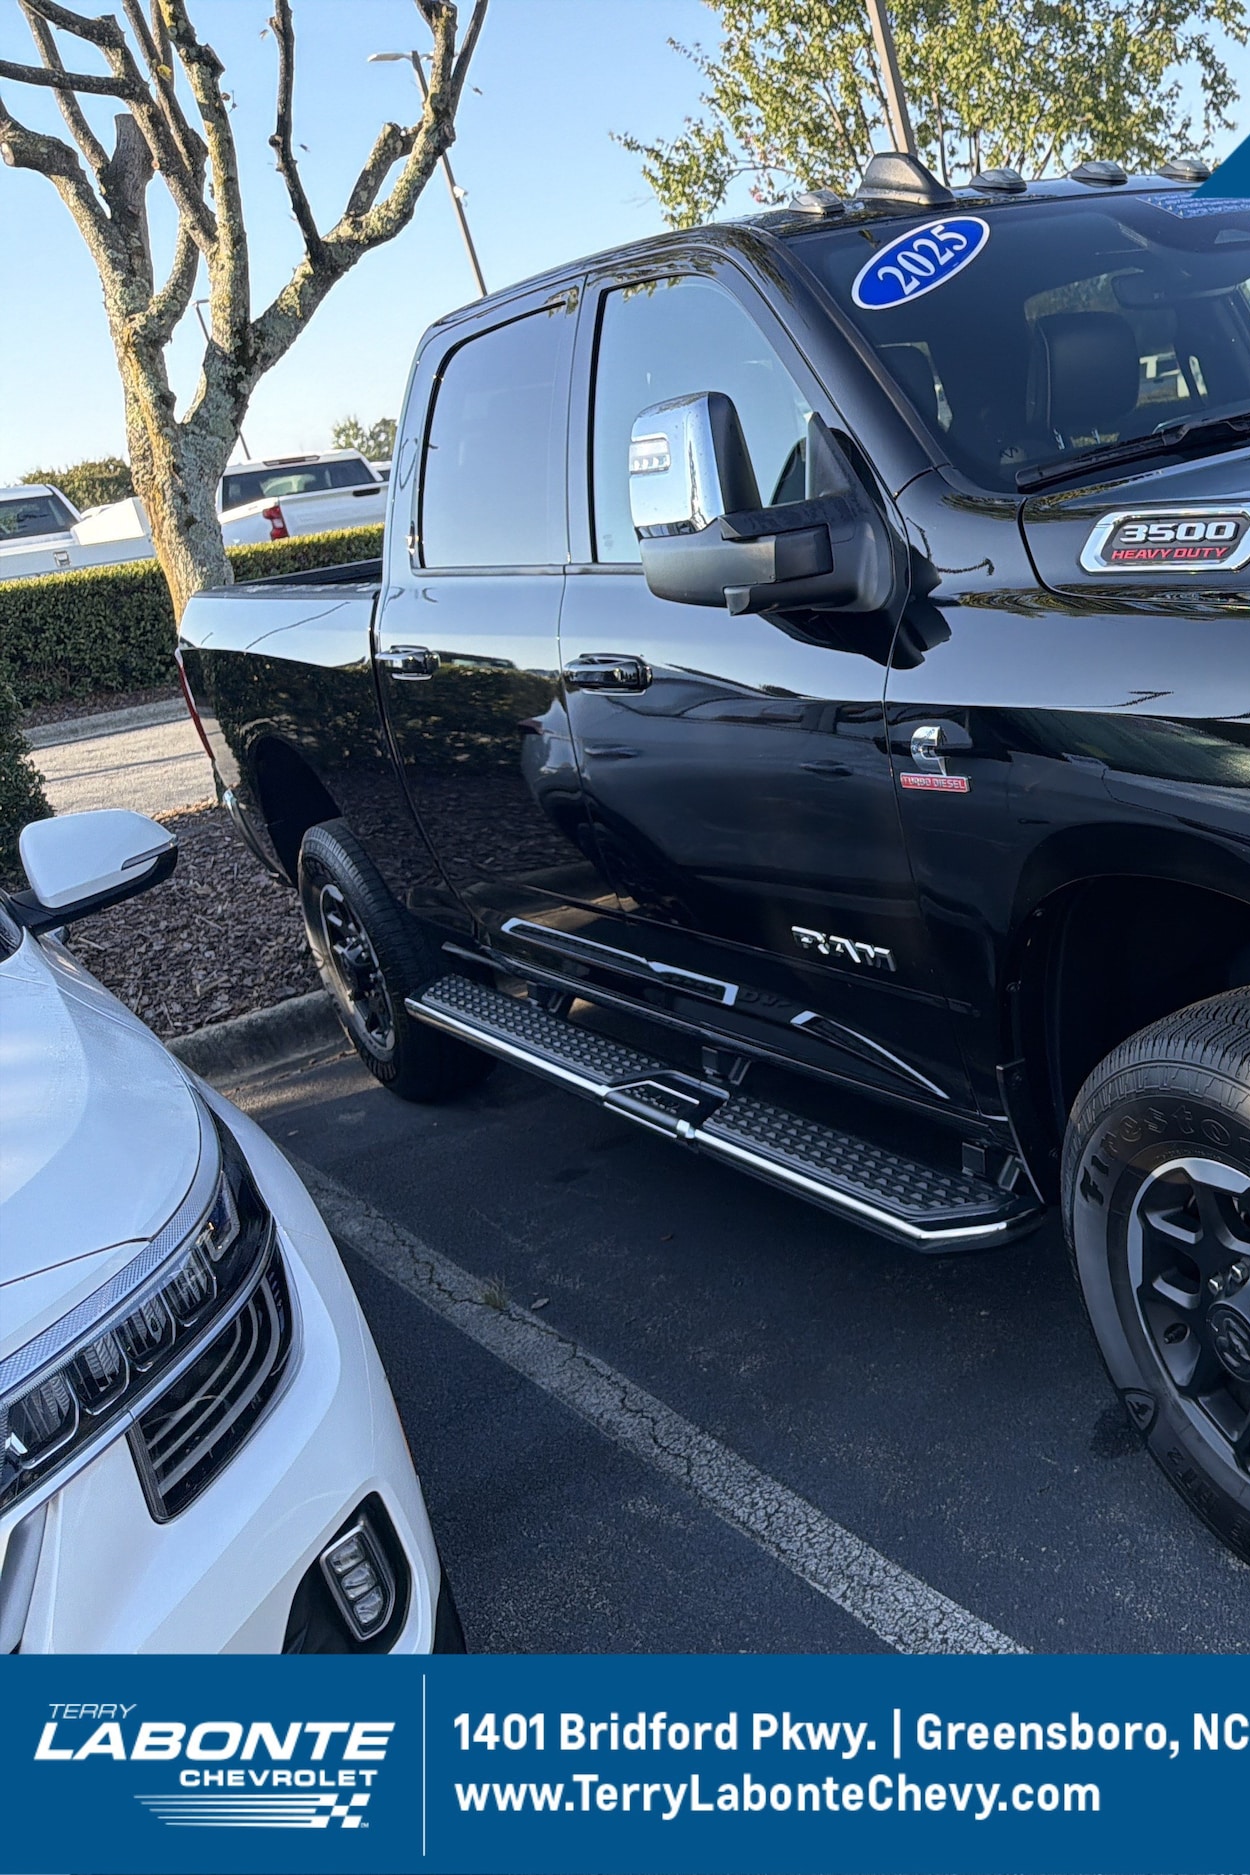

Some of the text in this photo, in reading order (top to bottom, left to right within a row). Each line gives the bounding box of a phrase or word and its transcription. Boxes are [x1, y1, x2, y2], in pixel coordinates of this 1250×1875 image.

[877, 224, 968, 296] 2025
[1119, 521, 1239, 545] 3500
[1111, 547, 1229, 560] HEAVY DUTY
[902, 775, 966, 790] TURBO DIESEL
[791, 925, 897, 972] RAM
